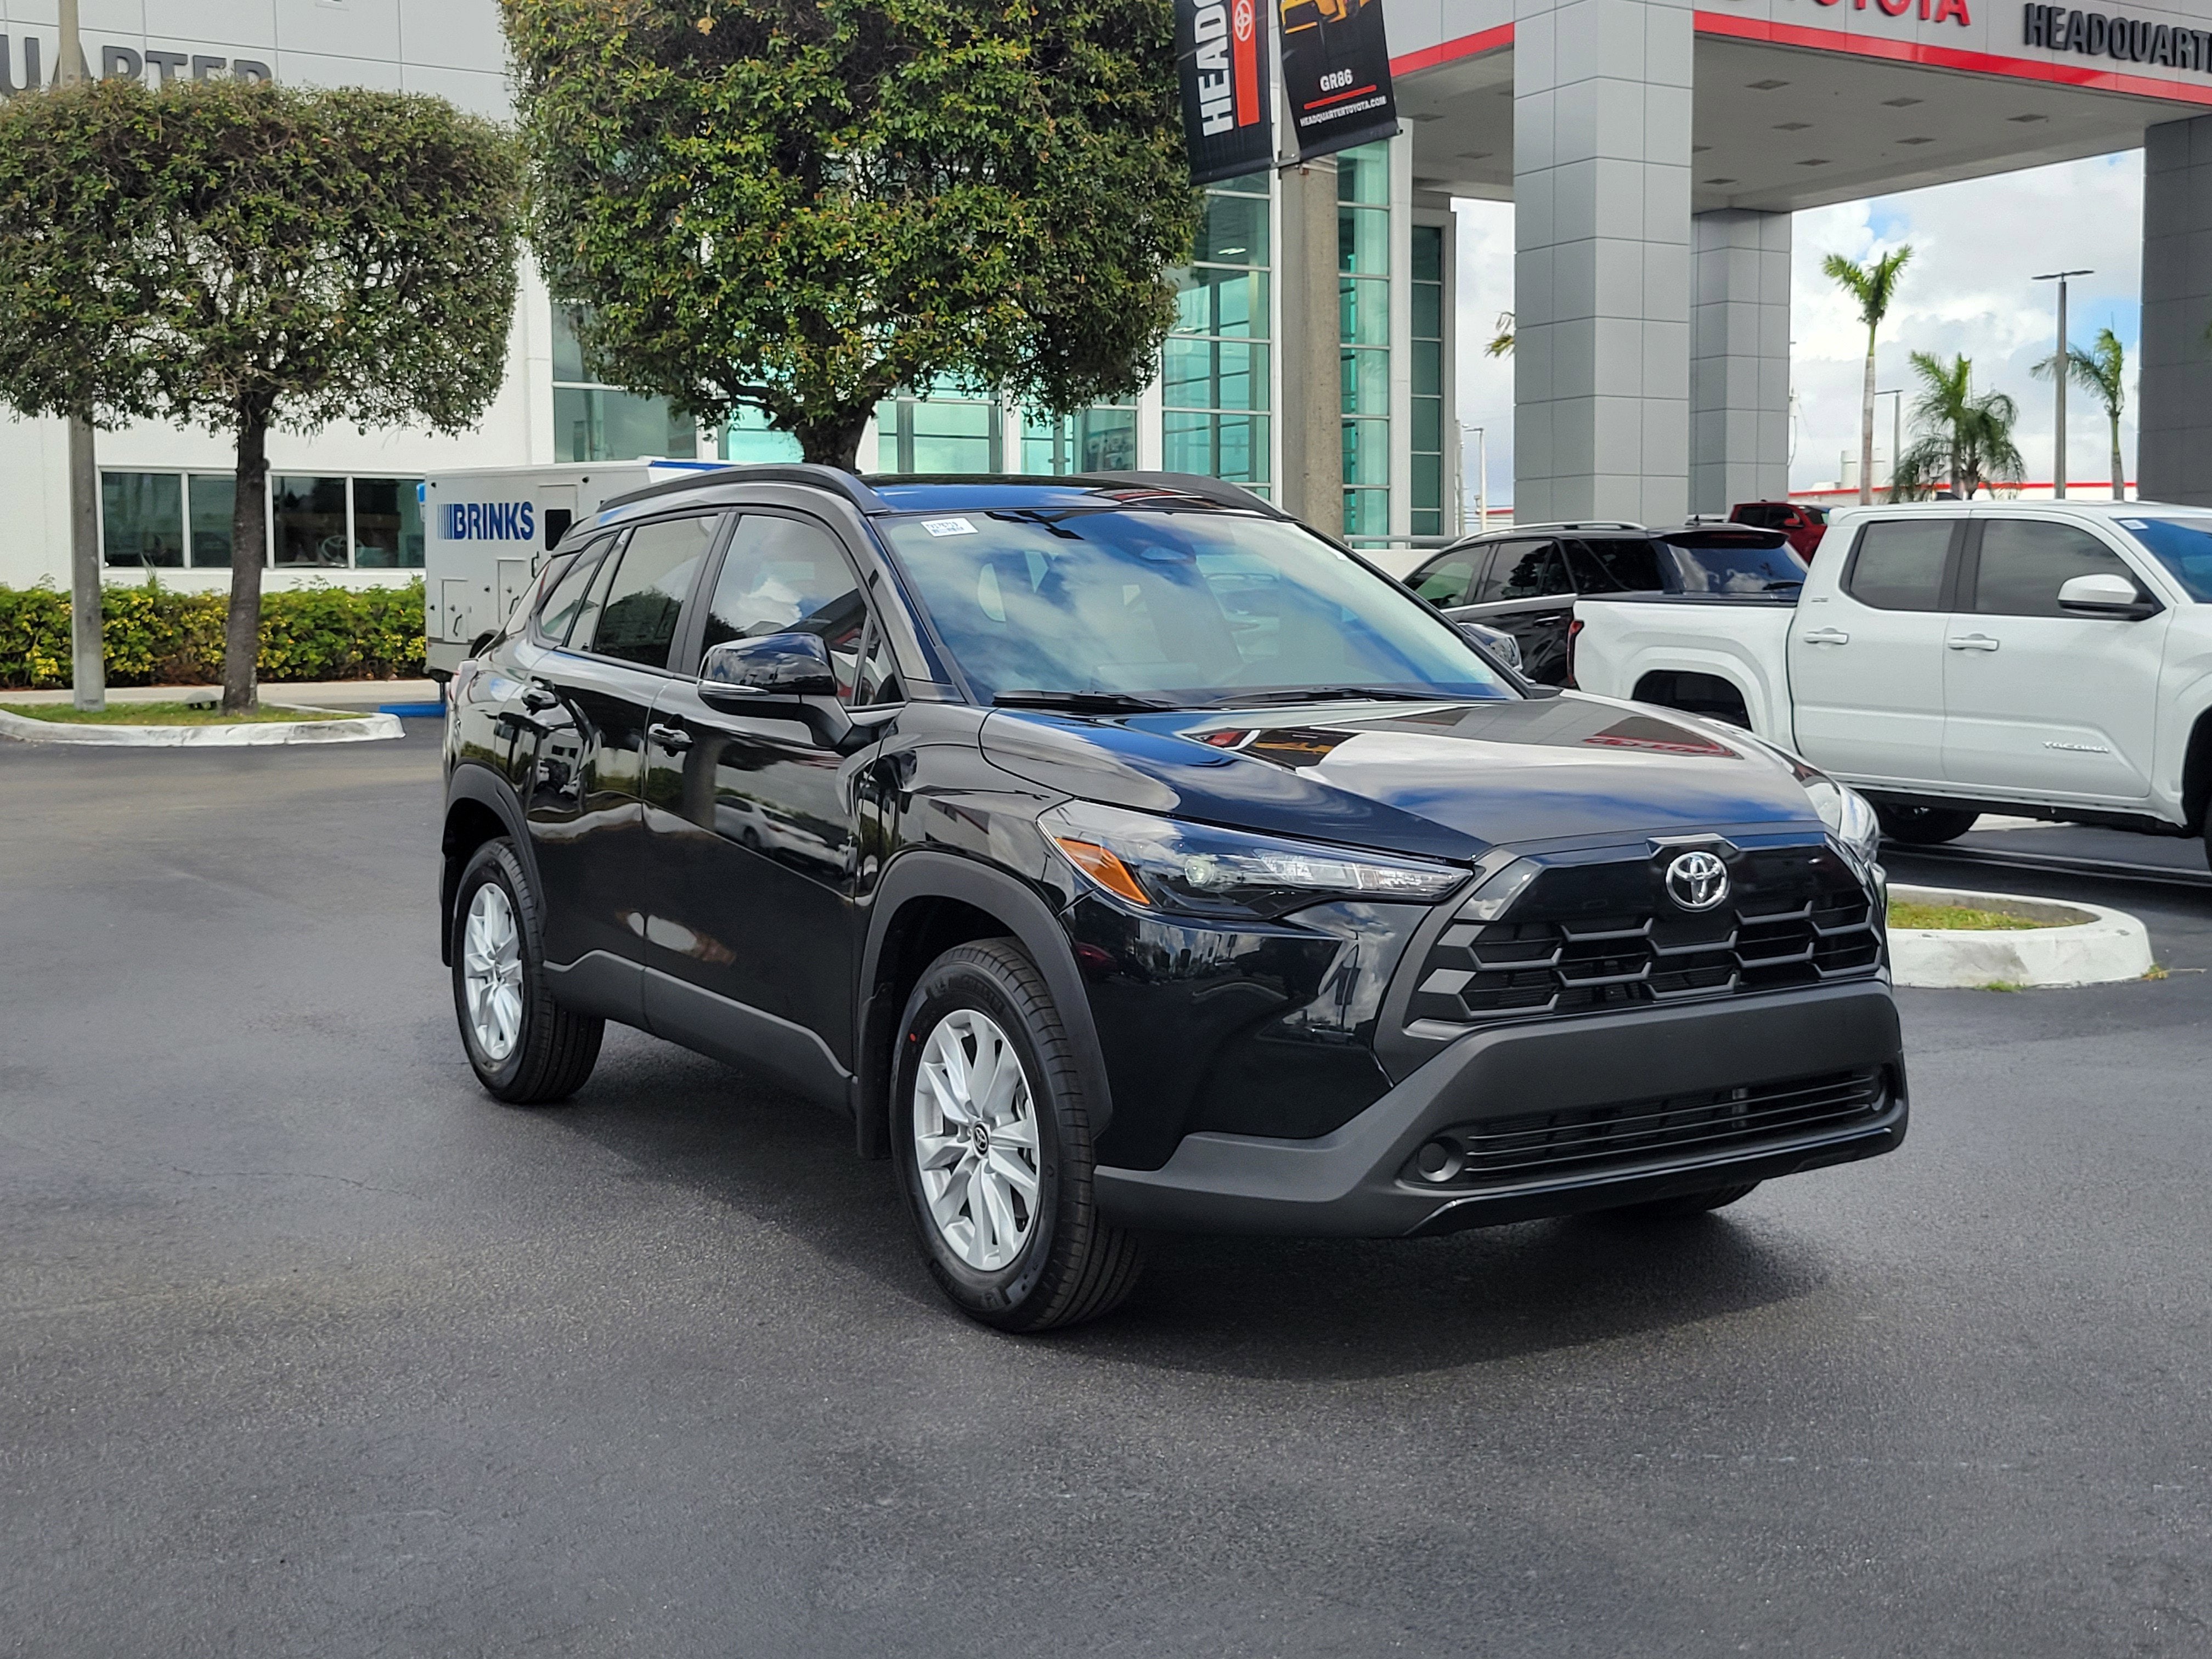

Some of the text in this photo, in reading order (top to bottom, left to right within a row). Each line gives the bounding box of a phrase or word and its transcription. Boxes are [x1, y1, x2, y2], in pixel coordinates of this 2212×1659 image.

[2024, 3, 2212, 73] HEADQUART
[1192, 0, 1234, 137] HEAD
[1320, 69, 1353, 91] GR86
[453, 501, 534, 540] BRINKS
